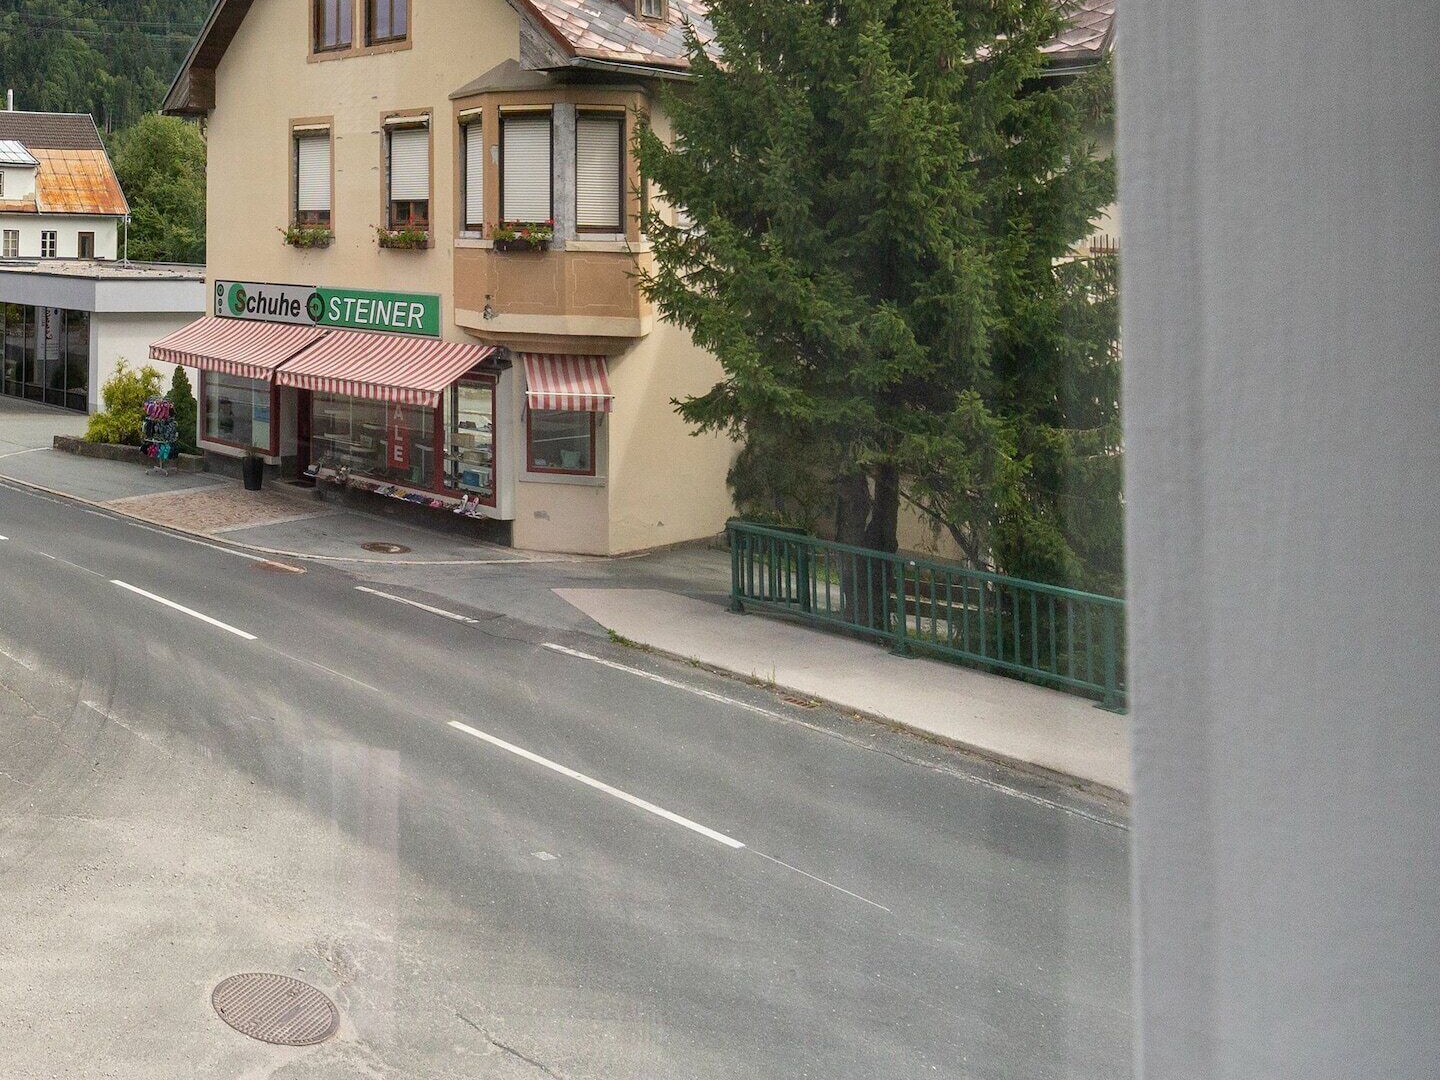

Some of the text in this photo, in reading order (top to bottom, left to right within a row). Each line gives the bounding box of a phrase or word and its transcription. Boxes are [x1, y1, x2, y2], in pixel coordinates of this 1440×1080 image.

[234, 285, 425, 329] Schuhe STEINER
[393, 403, 404, 463] ALE
